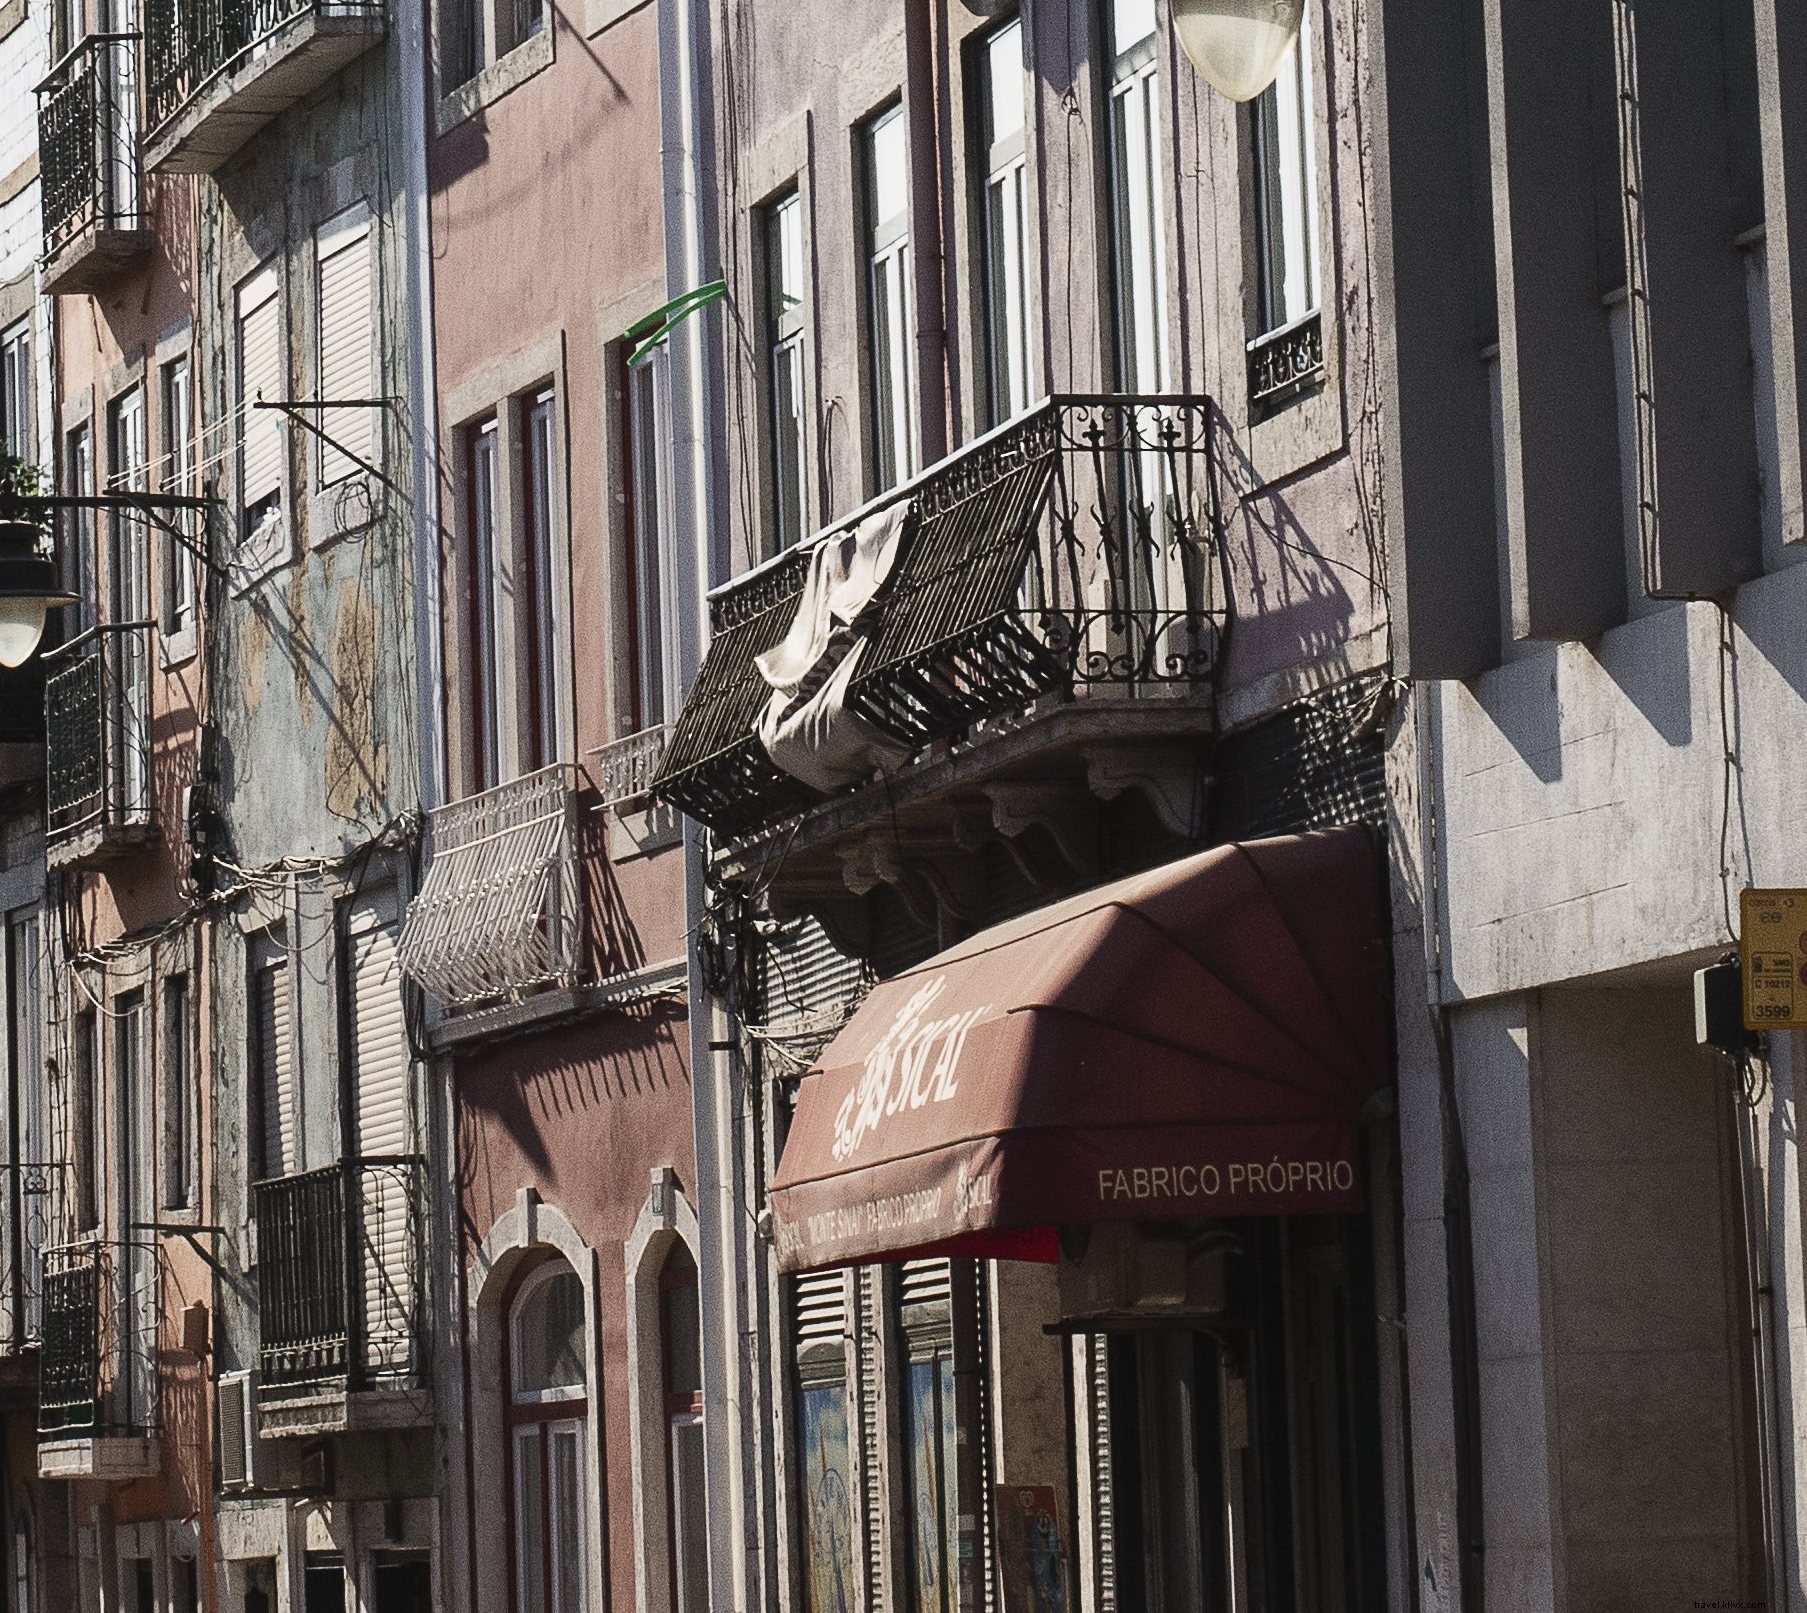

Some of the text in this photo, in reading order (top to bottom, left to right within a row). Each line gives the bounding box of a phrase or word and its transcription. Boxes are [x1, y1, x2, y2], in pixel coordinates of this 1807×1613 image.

[1755, 1005, 1791, 1018] 3599
[1098, 1155, 1353, 1200] FABRICO PRÓPRIO
